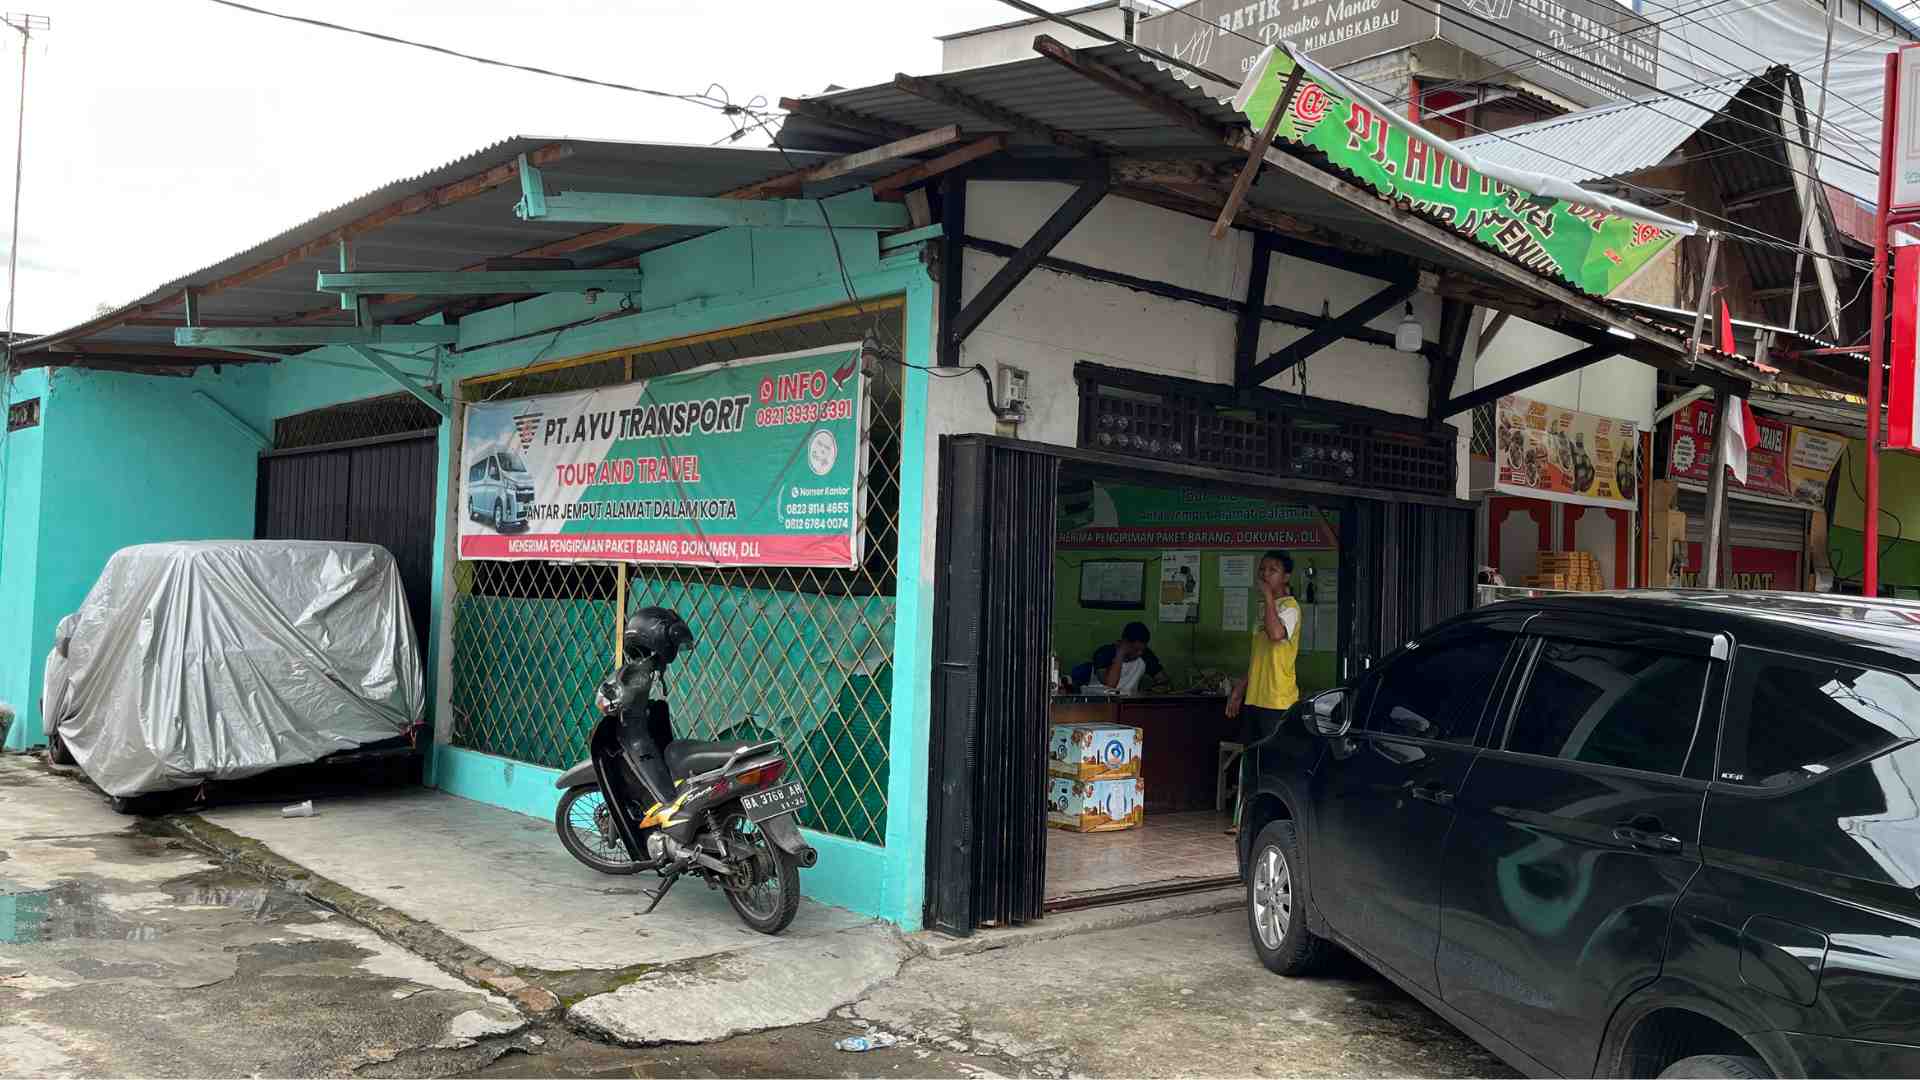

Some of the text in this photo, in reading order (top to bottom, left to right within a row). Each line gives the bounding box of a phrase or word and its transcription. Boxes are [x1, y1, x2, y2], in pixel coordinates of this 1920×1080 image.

[1304, 8, 1400, 51] MINANGKABAU
[777, 369, 828, 402] INFO
[544, 394, 751, 446] PT. AYU TRANSPORT
[756, 406, 785, 427] 0821
[819, 399, 853, 422] 3391
[556, 456, 702, 487] TOUR AND TRAVEL
[526, 498, 738, 520] ANTAR JEMPUT ALAMAT DALAM KOTA
[508, 539, 549, 553] MENERIMA
[605, 540, 635, 553] PAKET
[636, 540, 680, 557] BARANG,
[681, 541, 739, 560] DOKUMEN,
[740, 542, 760, 557] DLL
